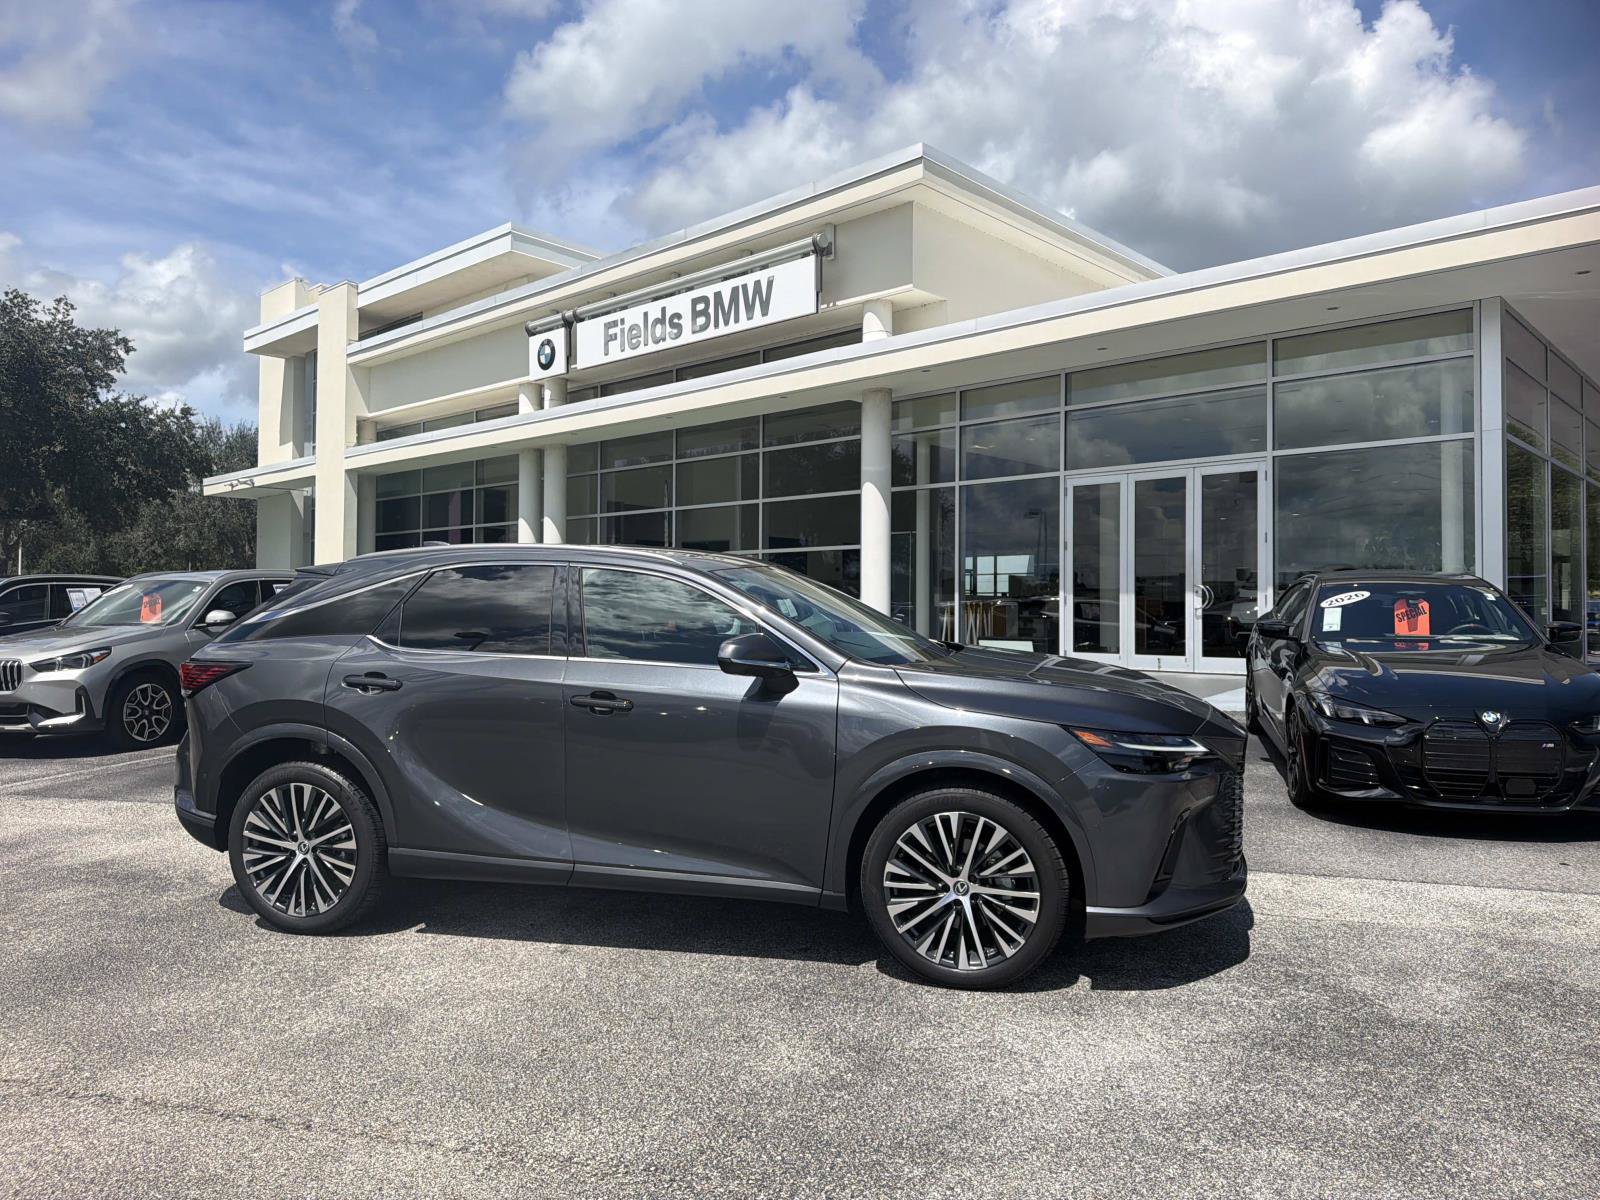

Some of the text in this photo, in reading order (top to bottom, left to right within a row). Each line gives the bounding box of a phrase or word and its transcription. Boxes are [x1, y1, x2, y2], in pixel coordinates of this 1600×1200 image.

[603, 275, 775, 356] Fields BMW
[1395, 605, 1428, 623] SPECIAL
